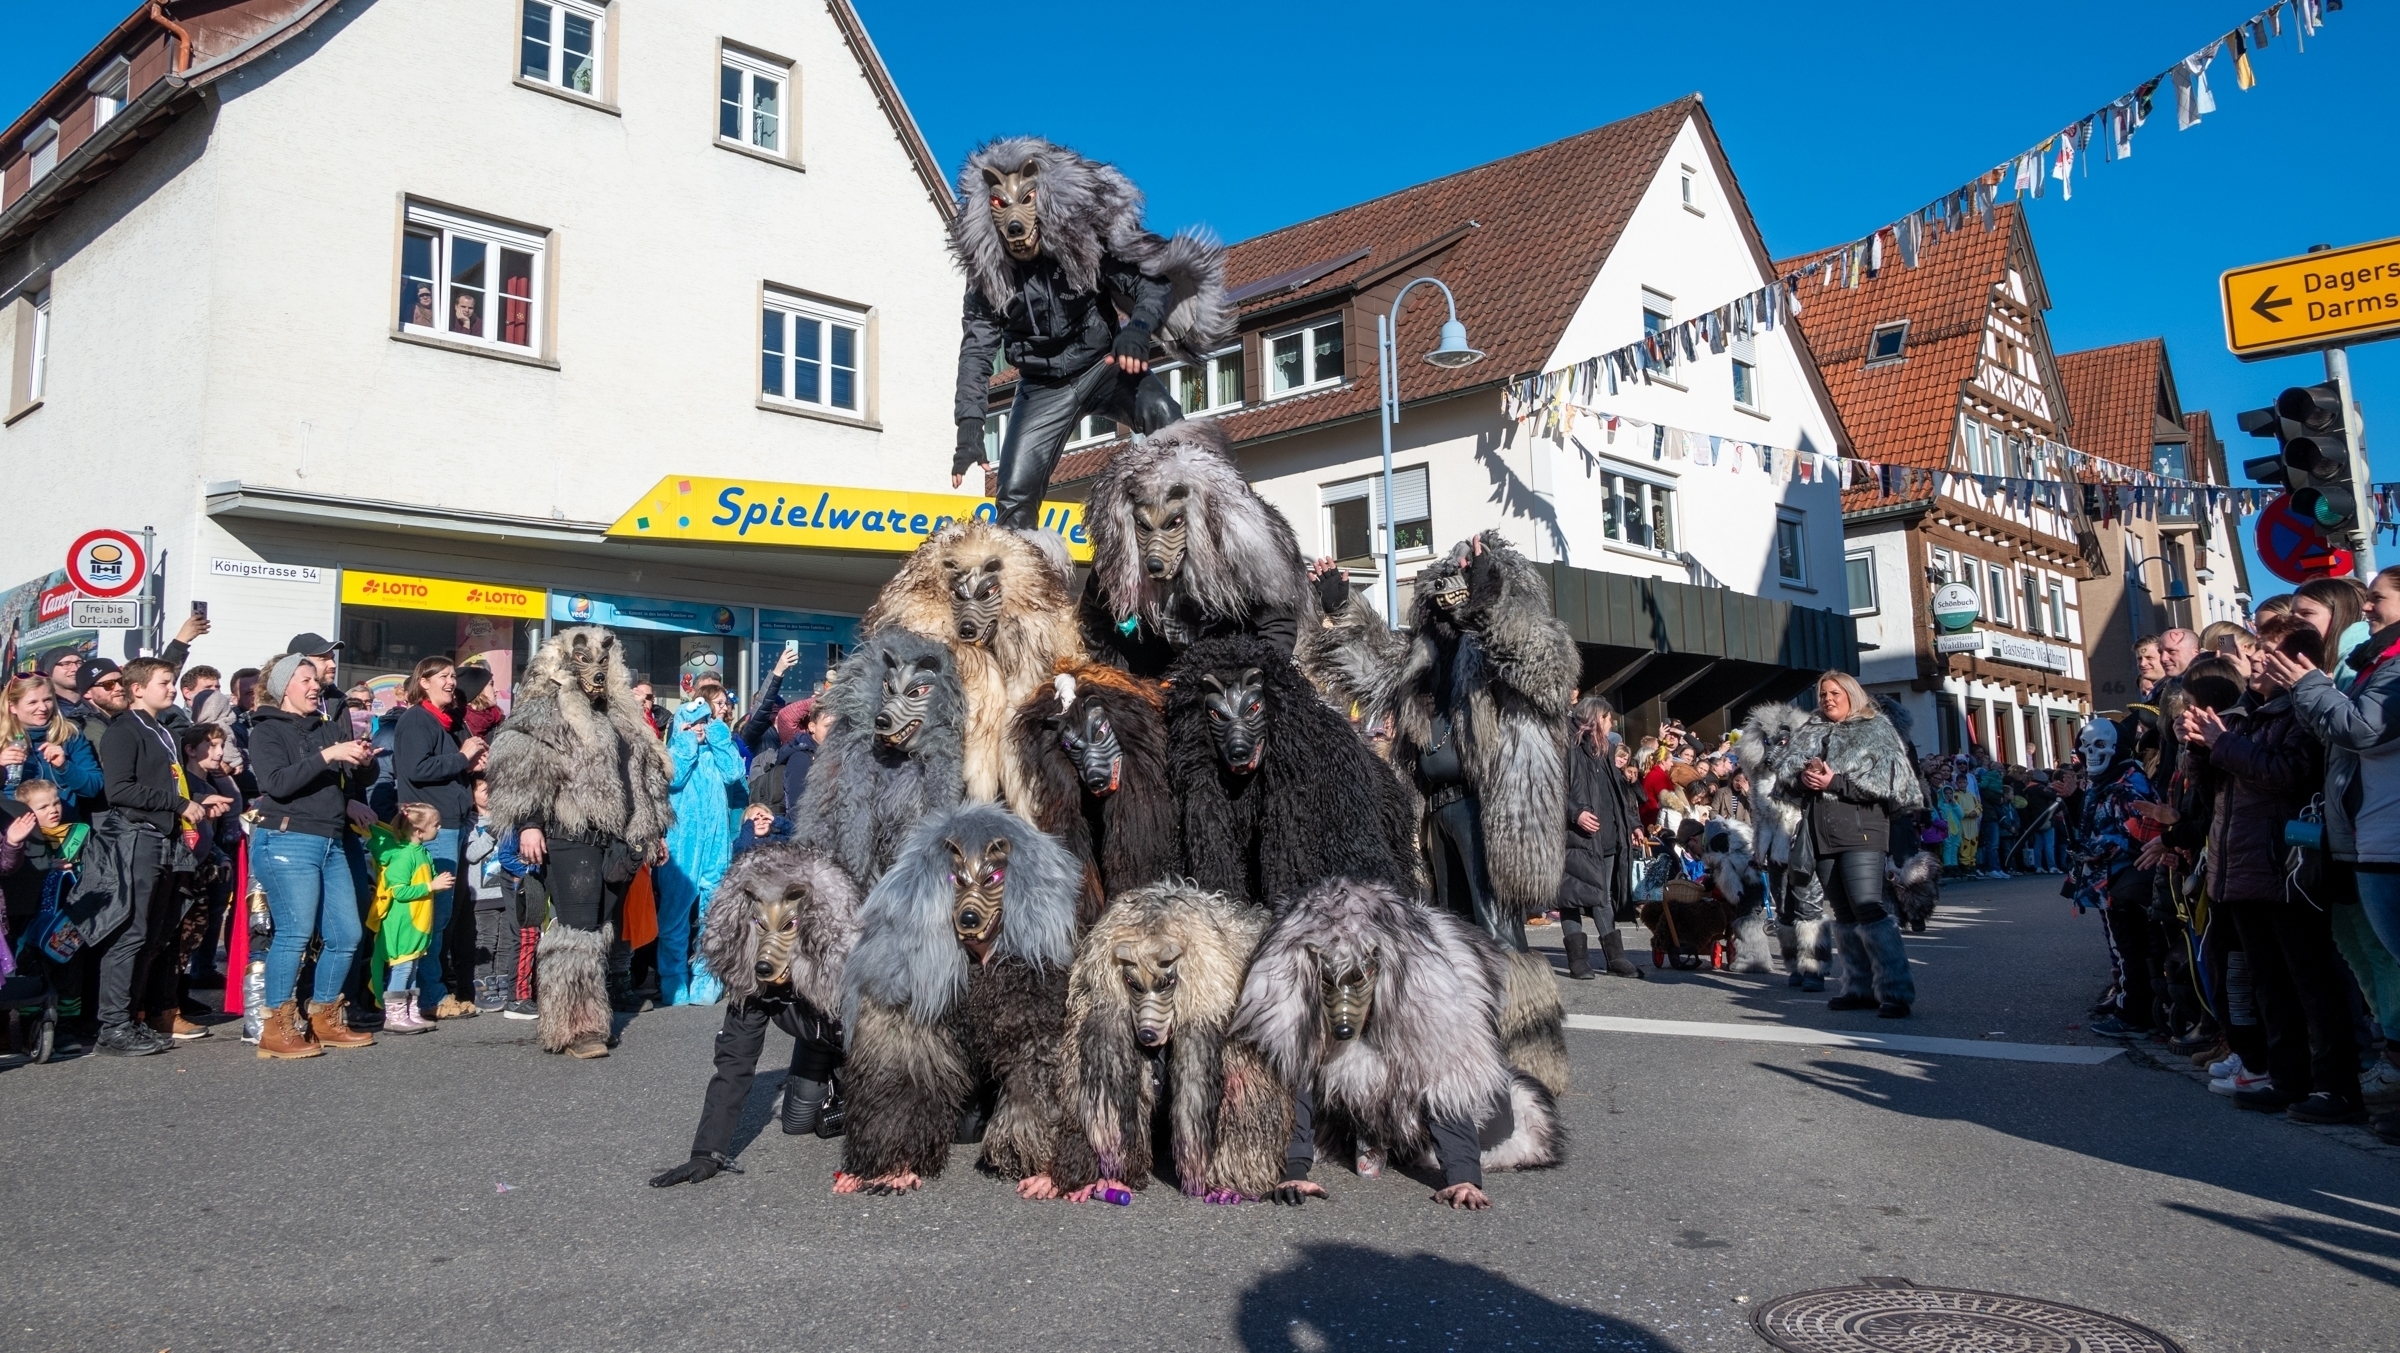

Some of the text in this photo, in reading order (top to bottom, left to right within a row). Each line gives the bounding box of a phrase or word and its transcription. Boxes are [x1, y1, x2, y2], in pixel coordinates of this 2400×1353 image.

[2307, 292, 2399, 322] Darms
[215, 560, 317, 579] Königstrasse 54
[382, 582, 428, 597] LOTTO
[485, 591, 527, 606] LOTTO
[1937, 598, 1974, 609] Schönbuch
[86, 604, 123, 613] frei bis
[570, 610, 590, 619] vedes
[79, 614, 130, 624] Ortsende
[714, 622, 731, 631] vedes
[1943, 634, 1974, 642] Gaststätte
[1940, 641, 1980, 650] Waldhorn
[2002, 639, 2035, 660] Gaststätte
[684, 650, 719, 667] 100
[2101, 680, 2127, 695] 46
